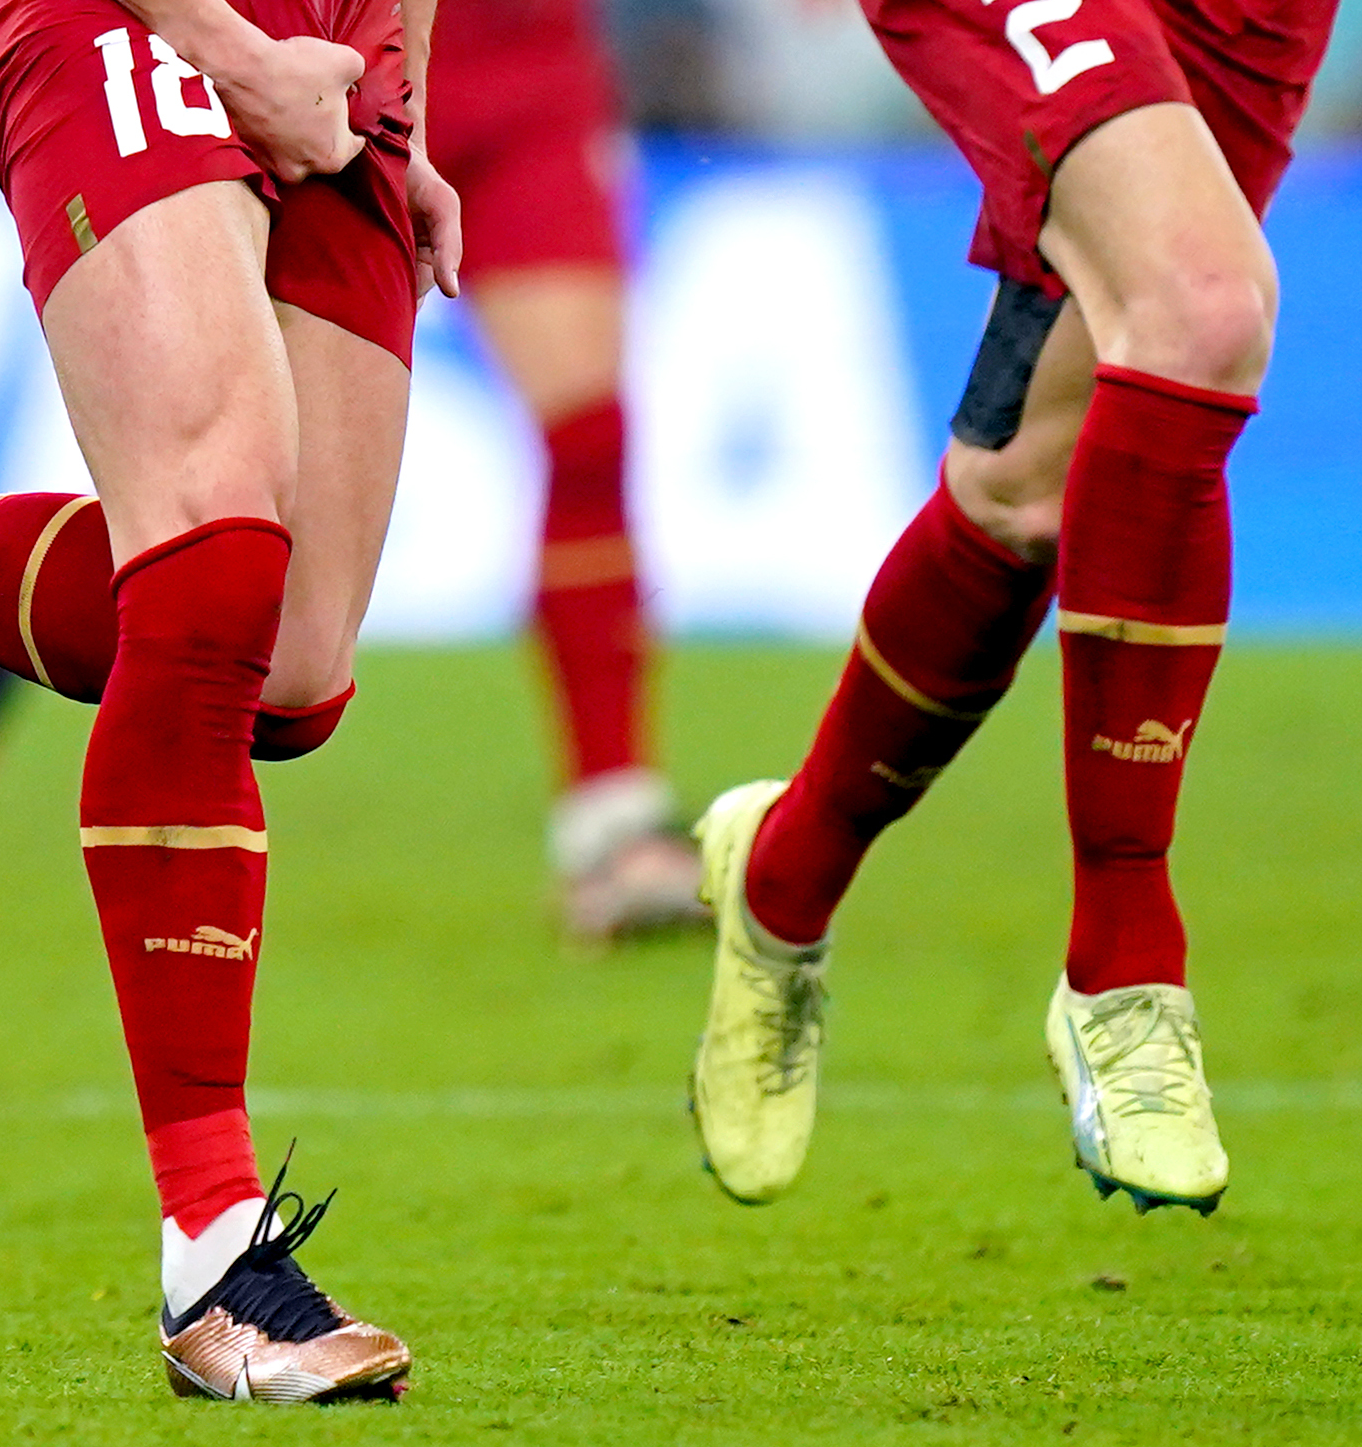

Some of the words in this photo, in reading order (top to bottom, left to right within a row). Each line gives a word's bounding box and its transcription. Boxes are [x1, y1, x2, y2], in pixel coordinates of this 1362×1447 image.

[94, 27, 232, 158] 18
[1091, 734, 1174, 764] PUMA
[144, 937, 244, 962] PUMA
